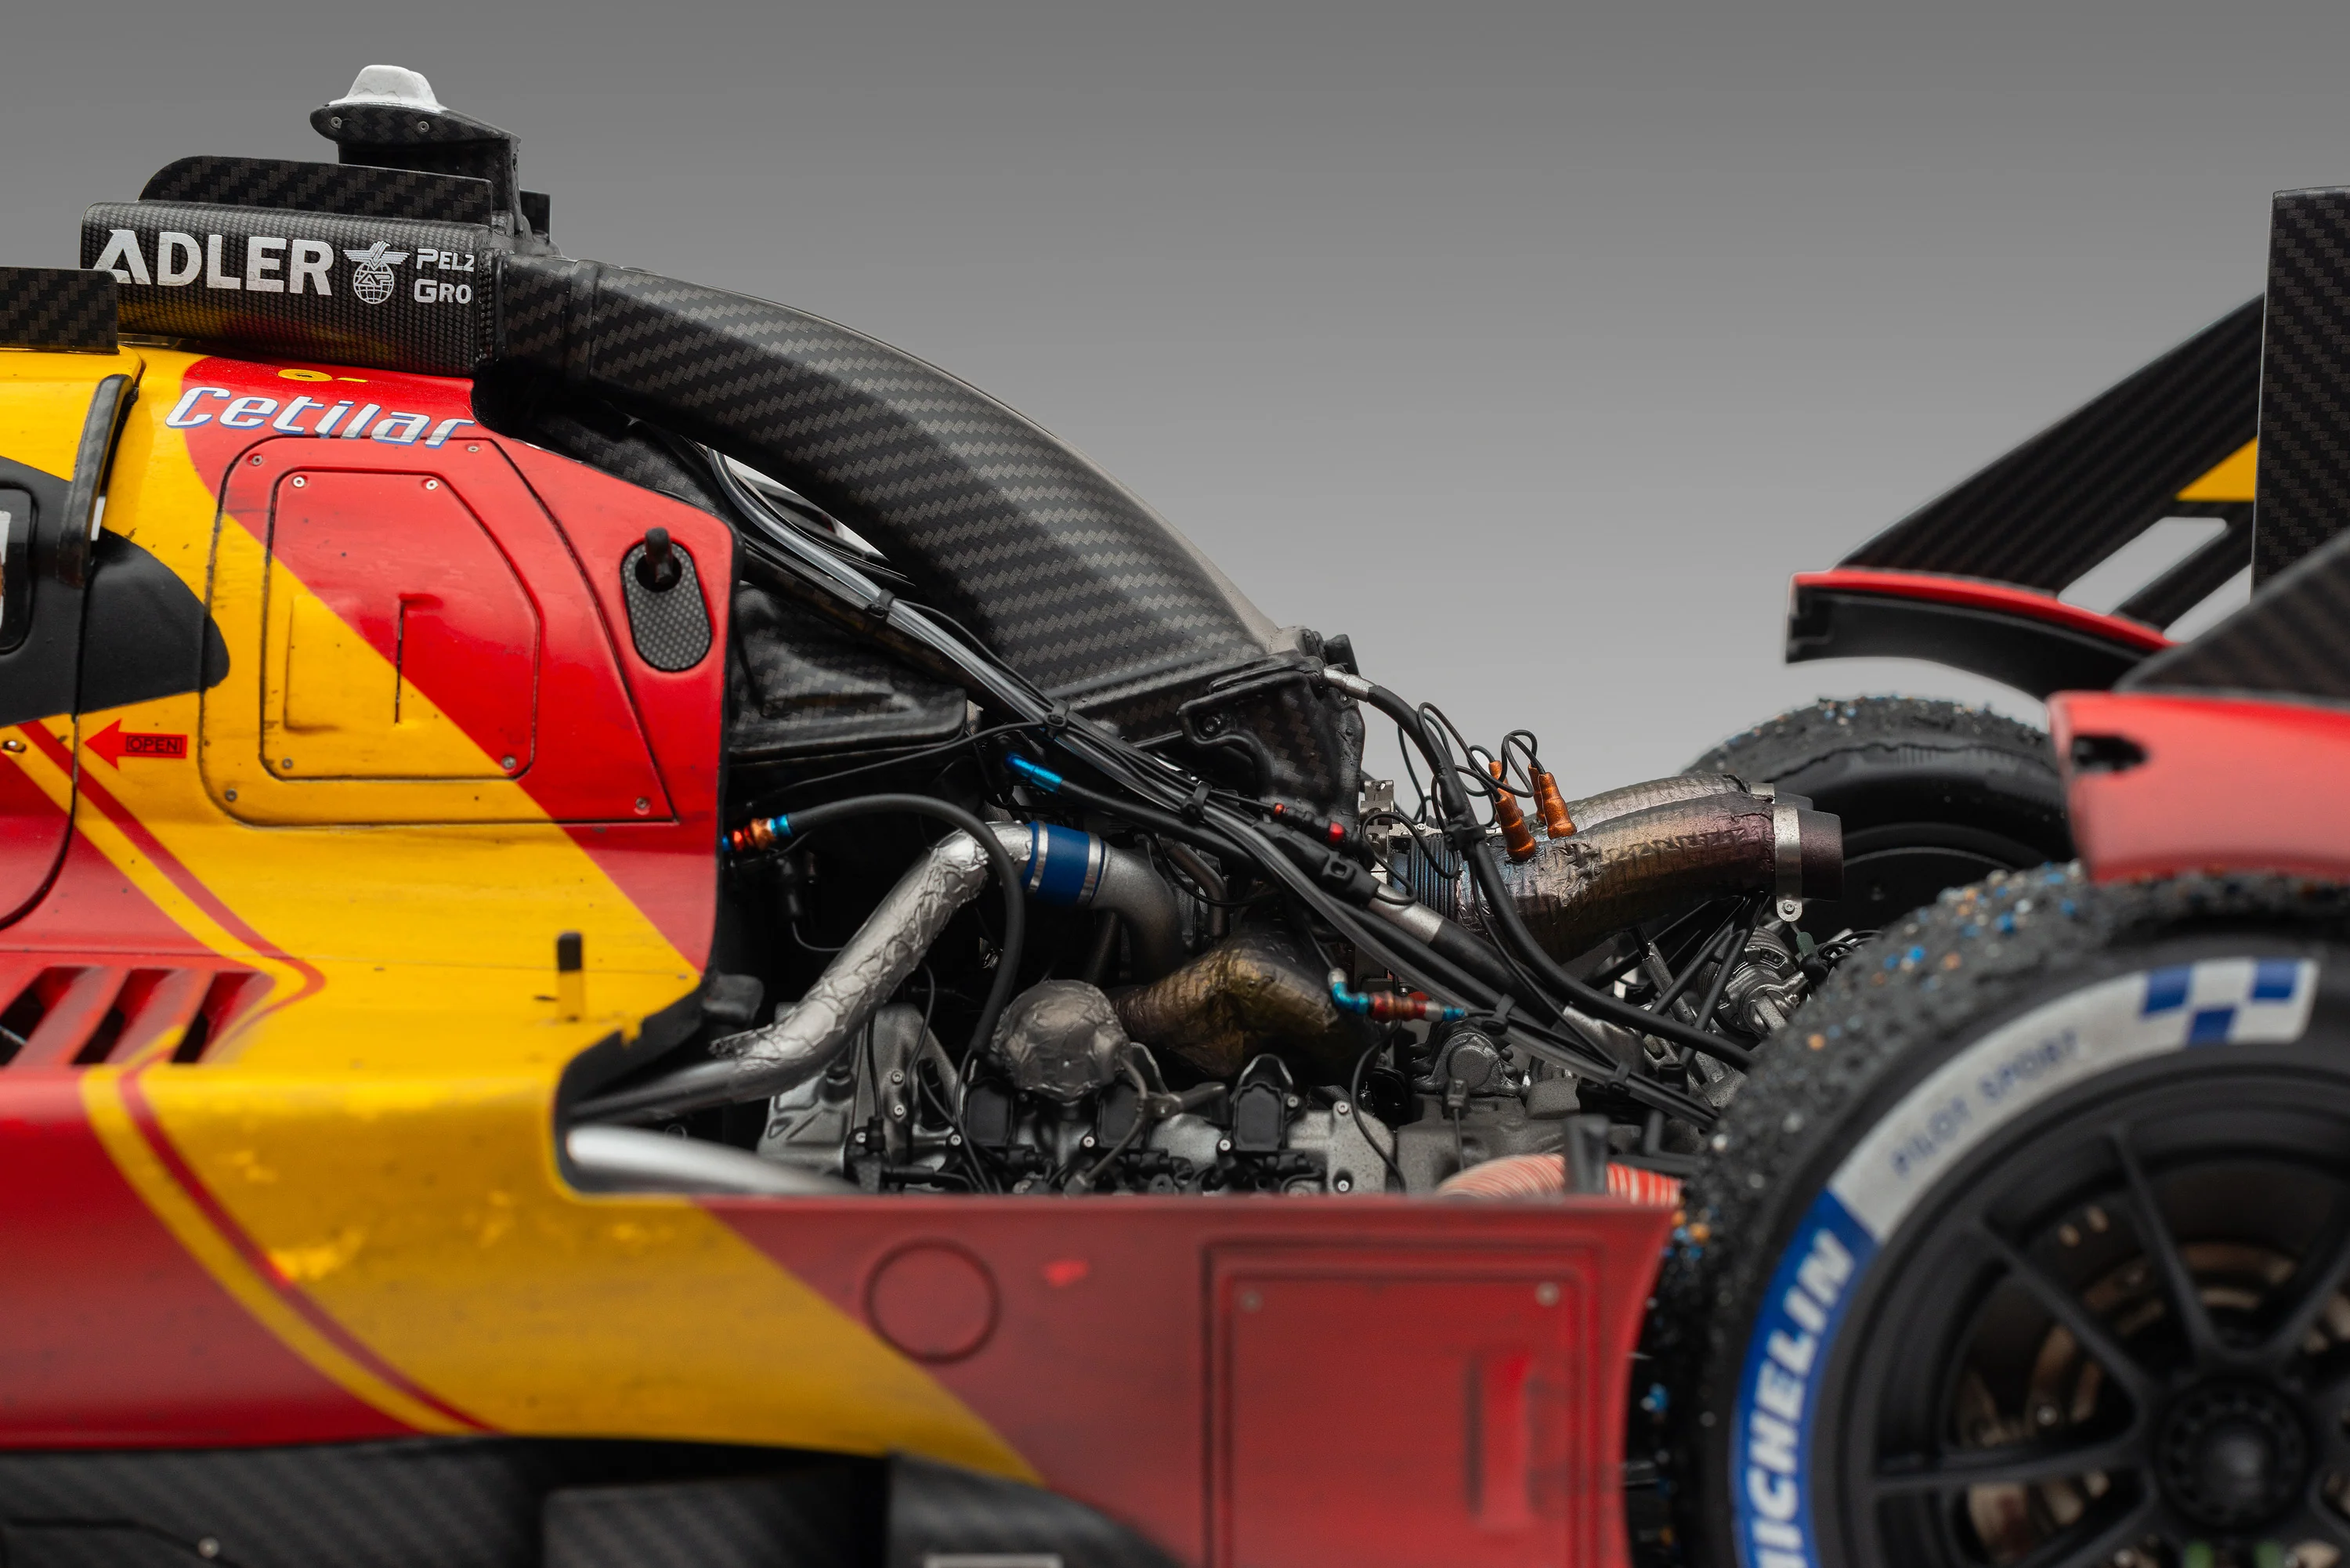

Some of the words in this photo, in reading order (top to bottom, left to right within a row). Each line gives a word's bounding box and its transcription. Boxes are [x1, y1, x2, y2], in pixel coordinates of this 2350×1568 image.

[93, 229, 334, 295] ADLER
[416, 247, 475, 273] PELZ
[414, 278, 472, 305] GRO
[165, 386, 475, 450] Cetilar
[129, 737, 178, 752] OPEN
